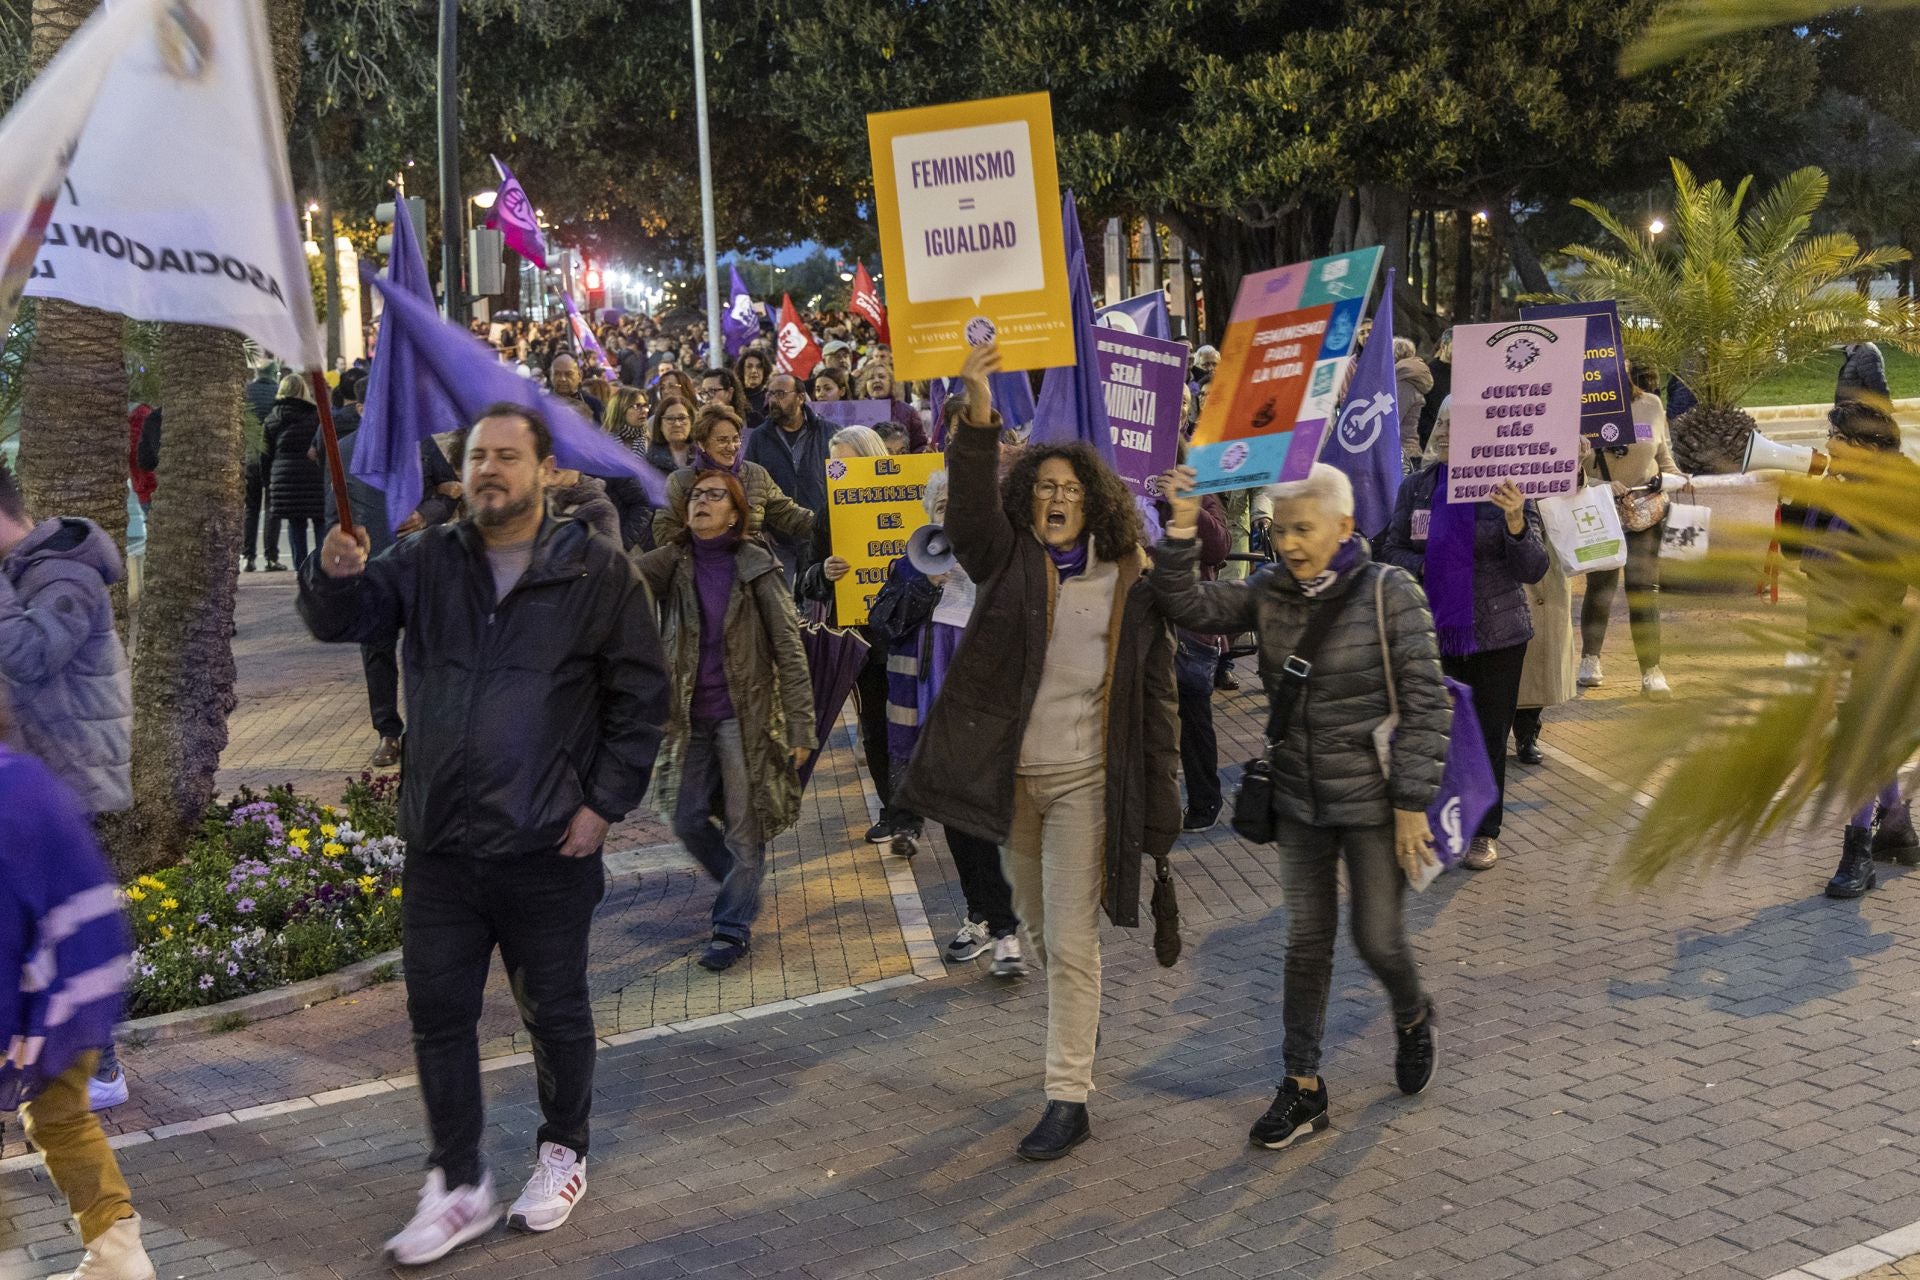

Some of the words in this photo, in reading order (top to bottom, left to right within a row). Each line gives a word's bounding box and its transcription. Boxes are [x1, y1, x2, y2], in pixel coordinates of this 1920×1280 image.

[911, 149, 1016, 189] FEMINISMO
[924, 220, 1017, 257] IGUALDAD
[1014, 321, 1066, 335] FEMINISTA
[1251, 319, 1328, 347] FEMINISMO
[1097, 340, 1181, 368] REVOLUCIÓN
[1263, 343, 1302, 363] PARA
[1110, 362, 1143, 388] SERÁ
[1250, 367, 1271, 384] LA
[1582, 370, 1602, 382] os
[1481, 382, 1553, 400] JUNTAS
[1485, 402, 1547, 419] SOMOS
[1496, 420, 1534, 438] MÁS
[1121, 429, 1153, 454] SERÁ
[1470, 441, 1558, 459] FUERTES,
[875, 459, 901, 476] EL
[1451, 459, 1576, 480] INVENCIBLES
[877, 512, 905, 530] ES
